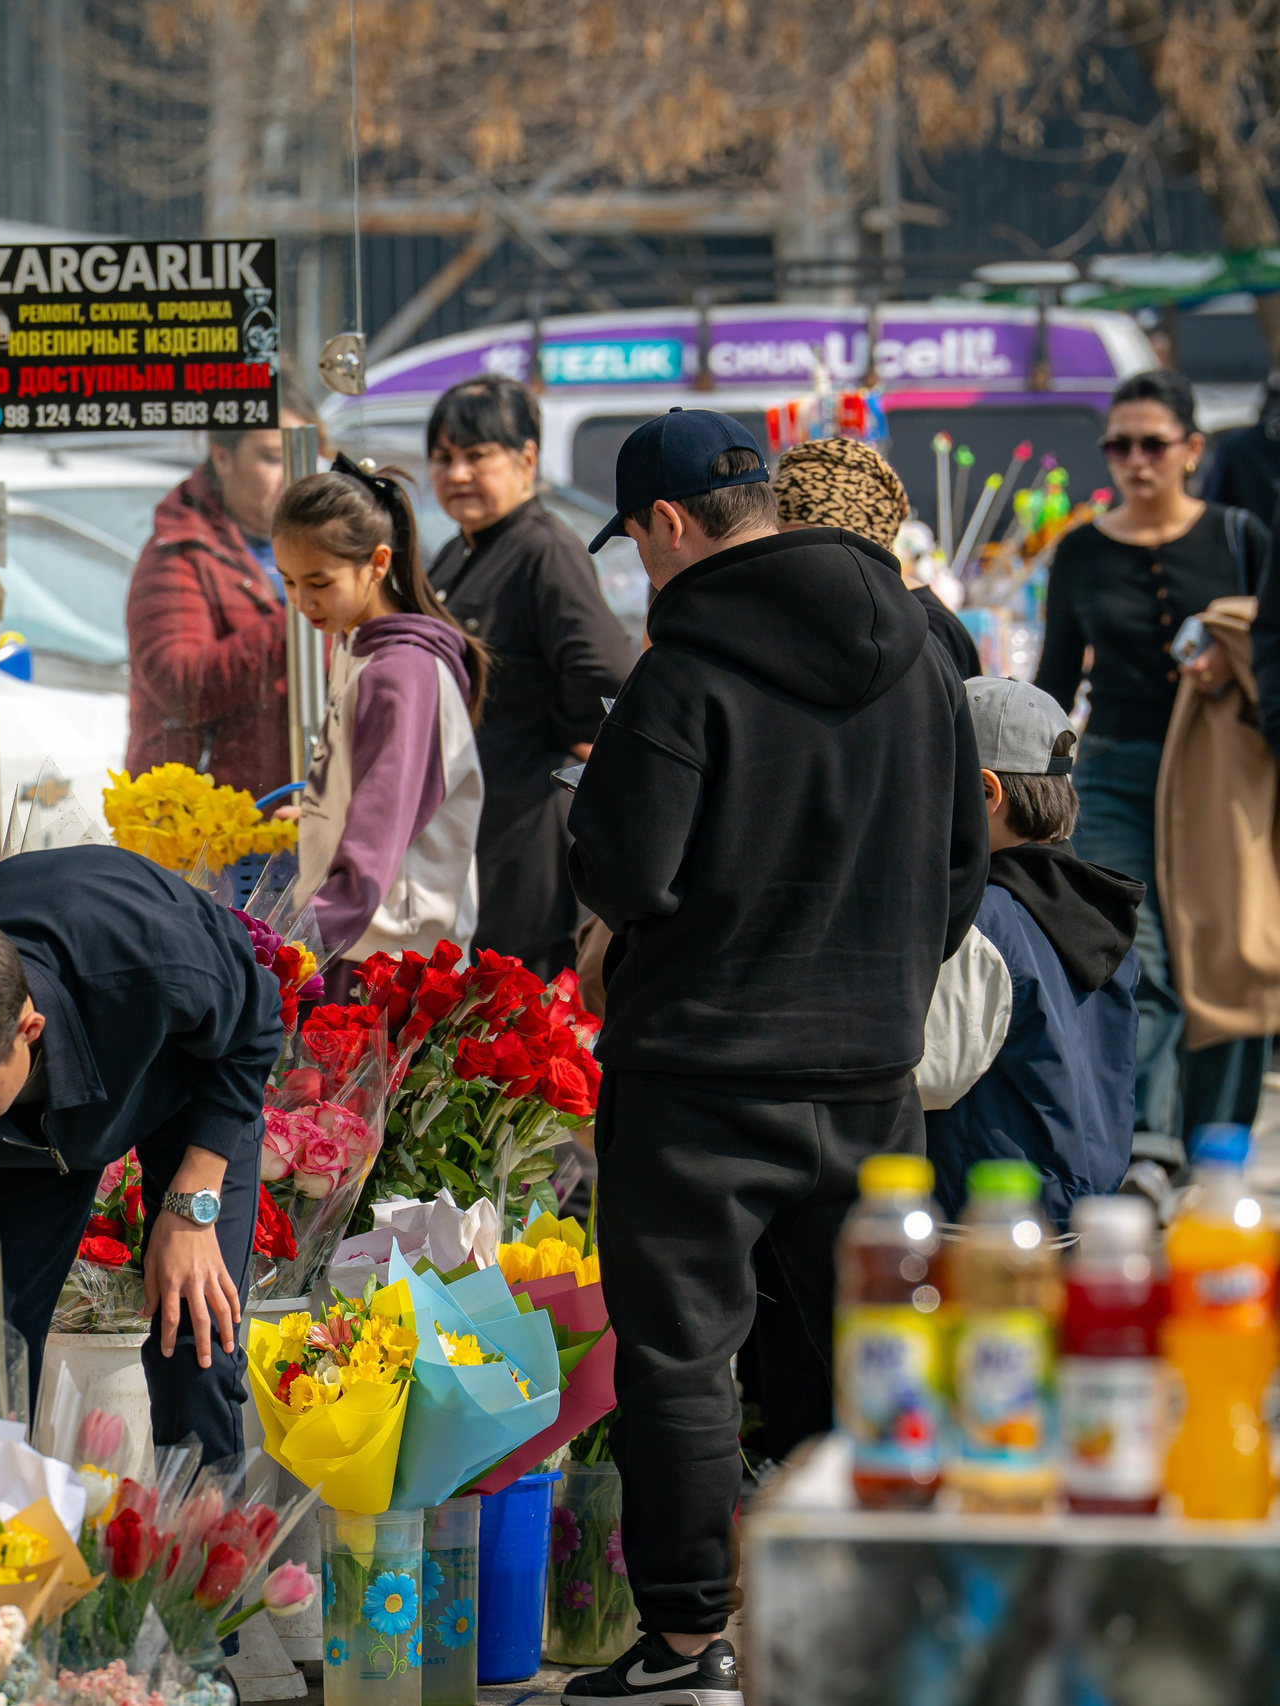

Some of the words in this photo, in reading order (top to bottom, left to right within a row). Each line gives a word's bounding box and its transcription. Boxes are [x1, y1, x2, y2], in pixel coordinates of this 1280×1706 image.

[18, 303, 86, 325] РЕМОНТ,
[89, 301, 154, 324] СКУПКА,
[157, 300, 233, 322] ПРОДАЖА
[8, 328, 138, 357] ЮВЕЛИРНЫЕ
[144, 326, 238, 357] ИЗДЕЛИЯ
[4, 404, 30, 428] 98
[35, 403, 71, 428] 124
[75, 402, 101, 427] 43
[105, 402, 137, 429] 24,
[141, 402, 167, 425] 55
[171, 401, 209, 425] 503
[213, 400, 239, 424] 43
[243, 400, 269, 423] 24
